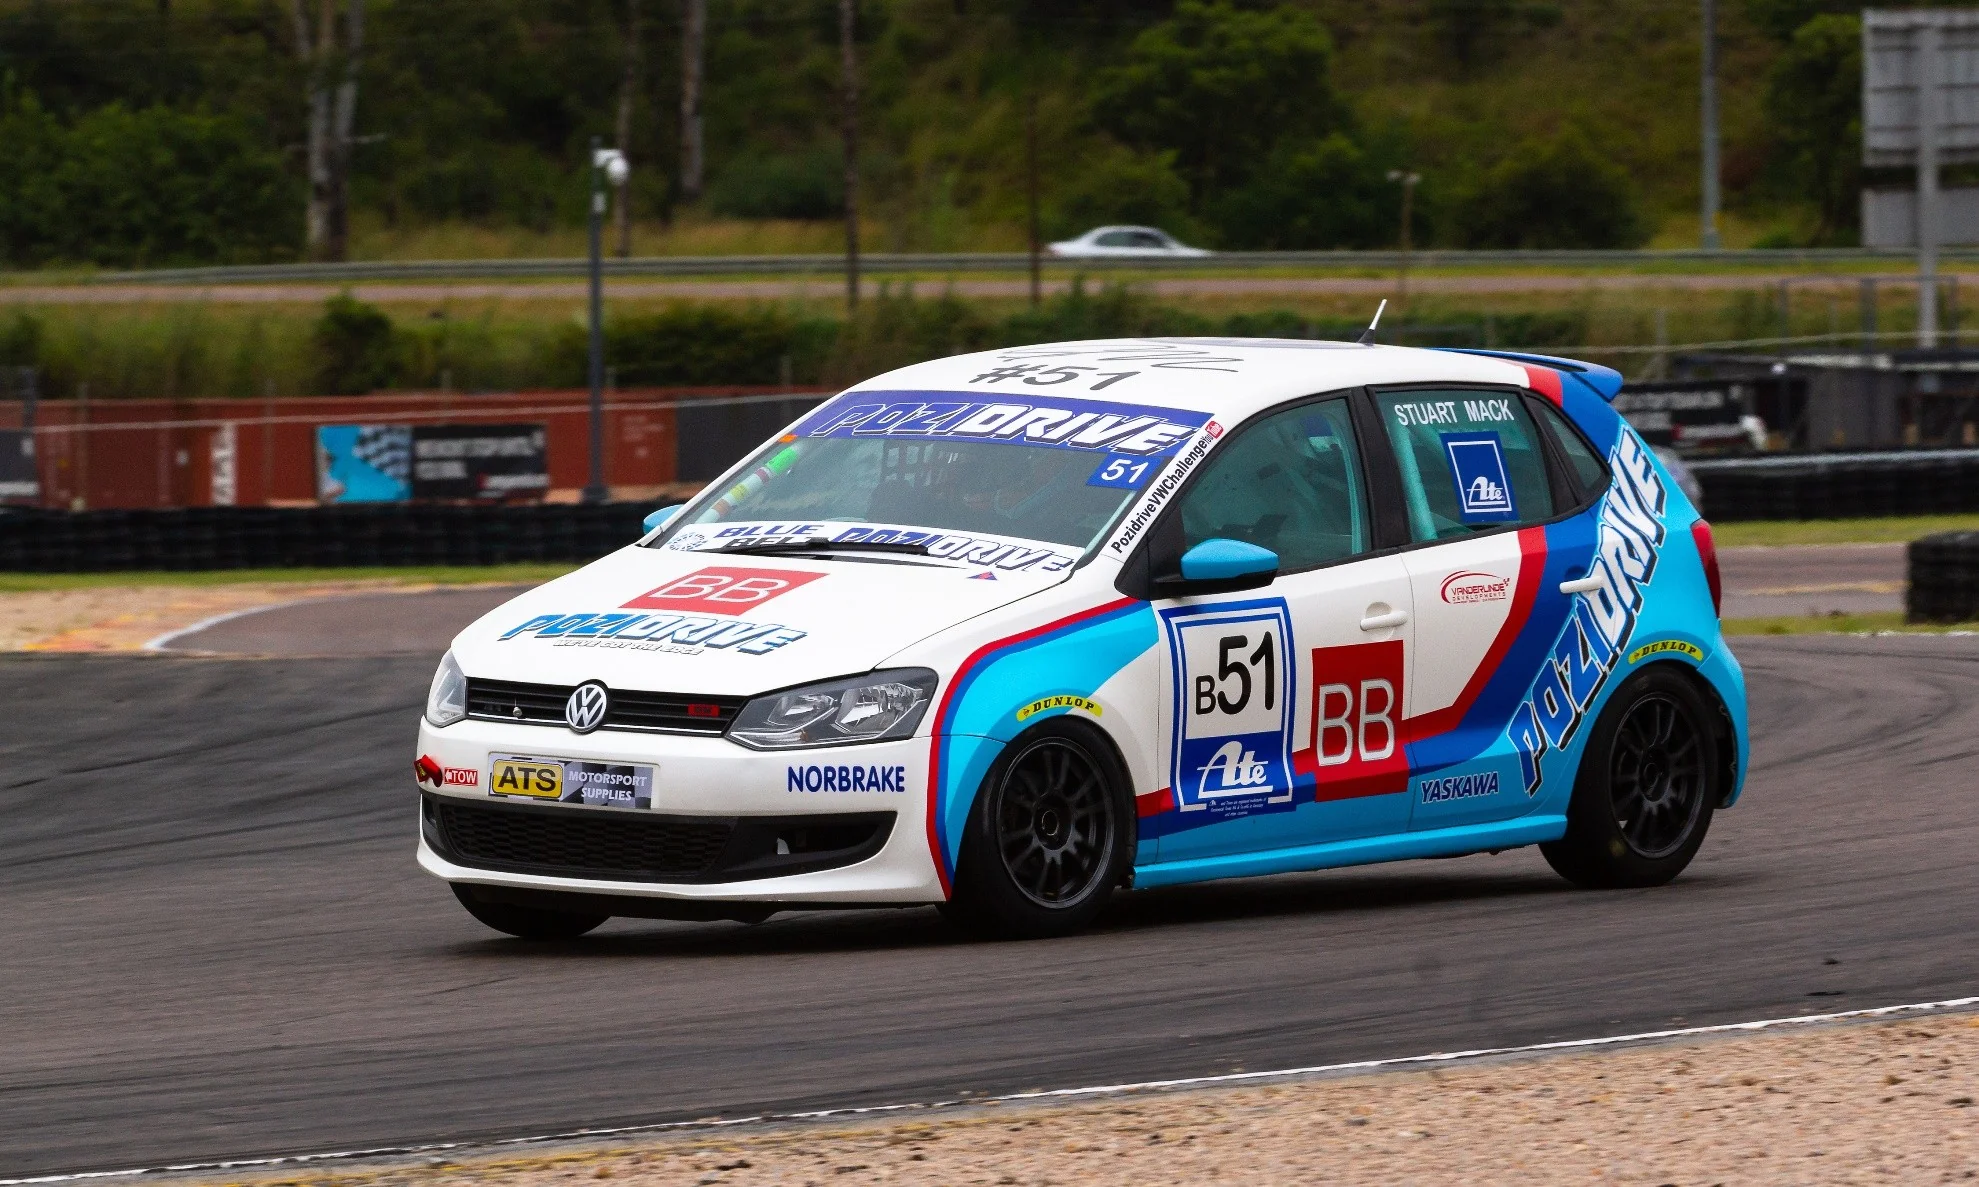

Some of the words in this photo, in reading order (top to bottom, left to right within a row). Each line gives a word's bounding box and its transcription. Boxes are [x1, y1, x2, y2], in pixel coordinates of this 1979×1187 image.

[968, 364, 1141, 390] #51
[1394, 401, 1455, 426] STUART
[1466, 399, 1514, 422] MACK
[808, 402, 1201, 456] POZIDRIVE
[1100, 459, 1149, 485] 51
[1111, 438, 1208, 554] PozidriveVWChallenge
[714, 525, 825, 539] BLUE
[648, 575, 789, 603] BB
[1451, 583, 1505, 596] VANDERLINDE
[1452, 592, 1506, 601] DEVELOPMENTS
[1507, 424, 1667, 798] POZIDRIVE
[497, 613, 807, 656] POZIDRIVE
[1641, 641, 1697, 656] DUNLOP
[1195, 631, 1275, 715] B51
[1033, 696, 1094, 713] DUNLOP
[1317, 678, 1395, 767] BB
[452, 770, 477, 784] TOW
[498, 766, 556, 792] ATS
[568, 770, 648, 787] MOTORSPORT
[787, 765, 905, 793] NORBRAKE
[1420, 771, 1499, 804] YASKAWA
[581, 787, 632, 802] SUPPLIES
